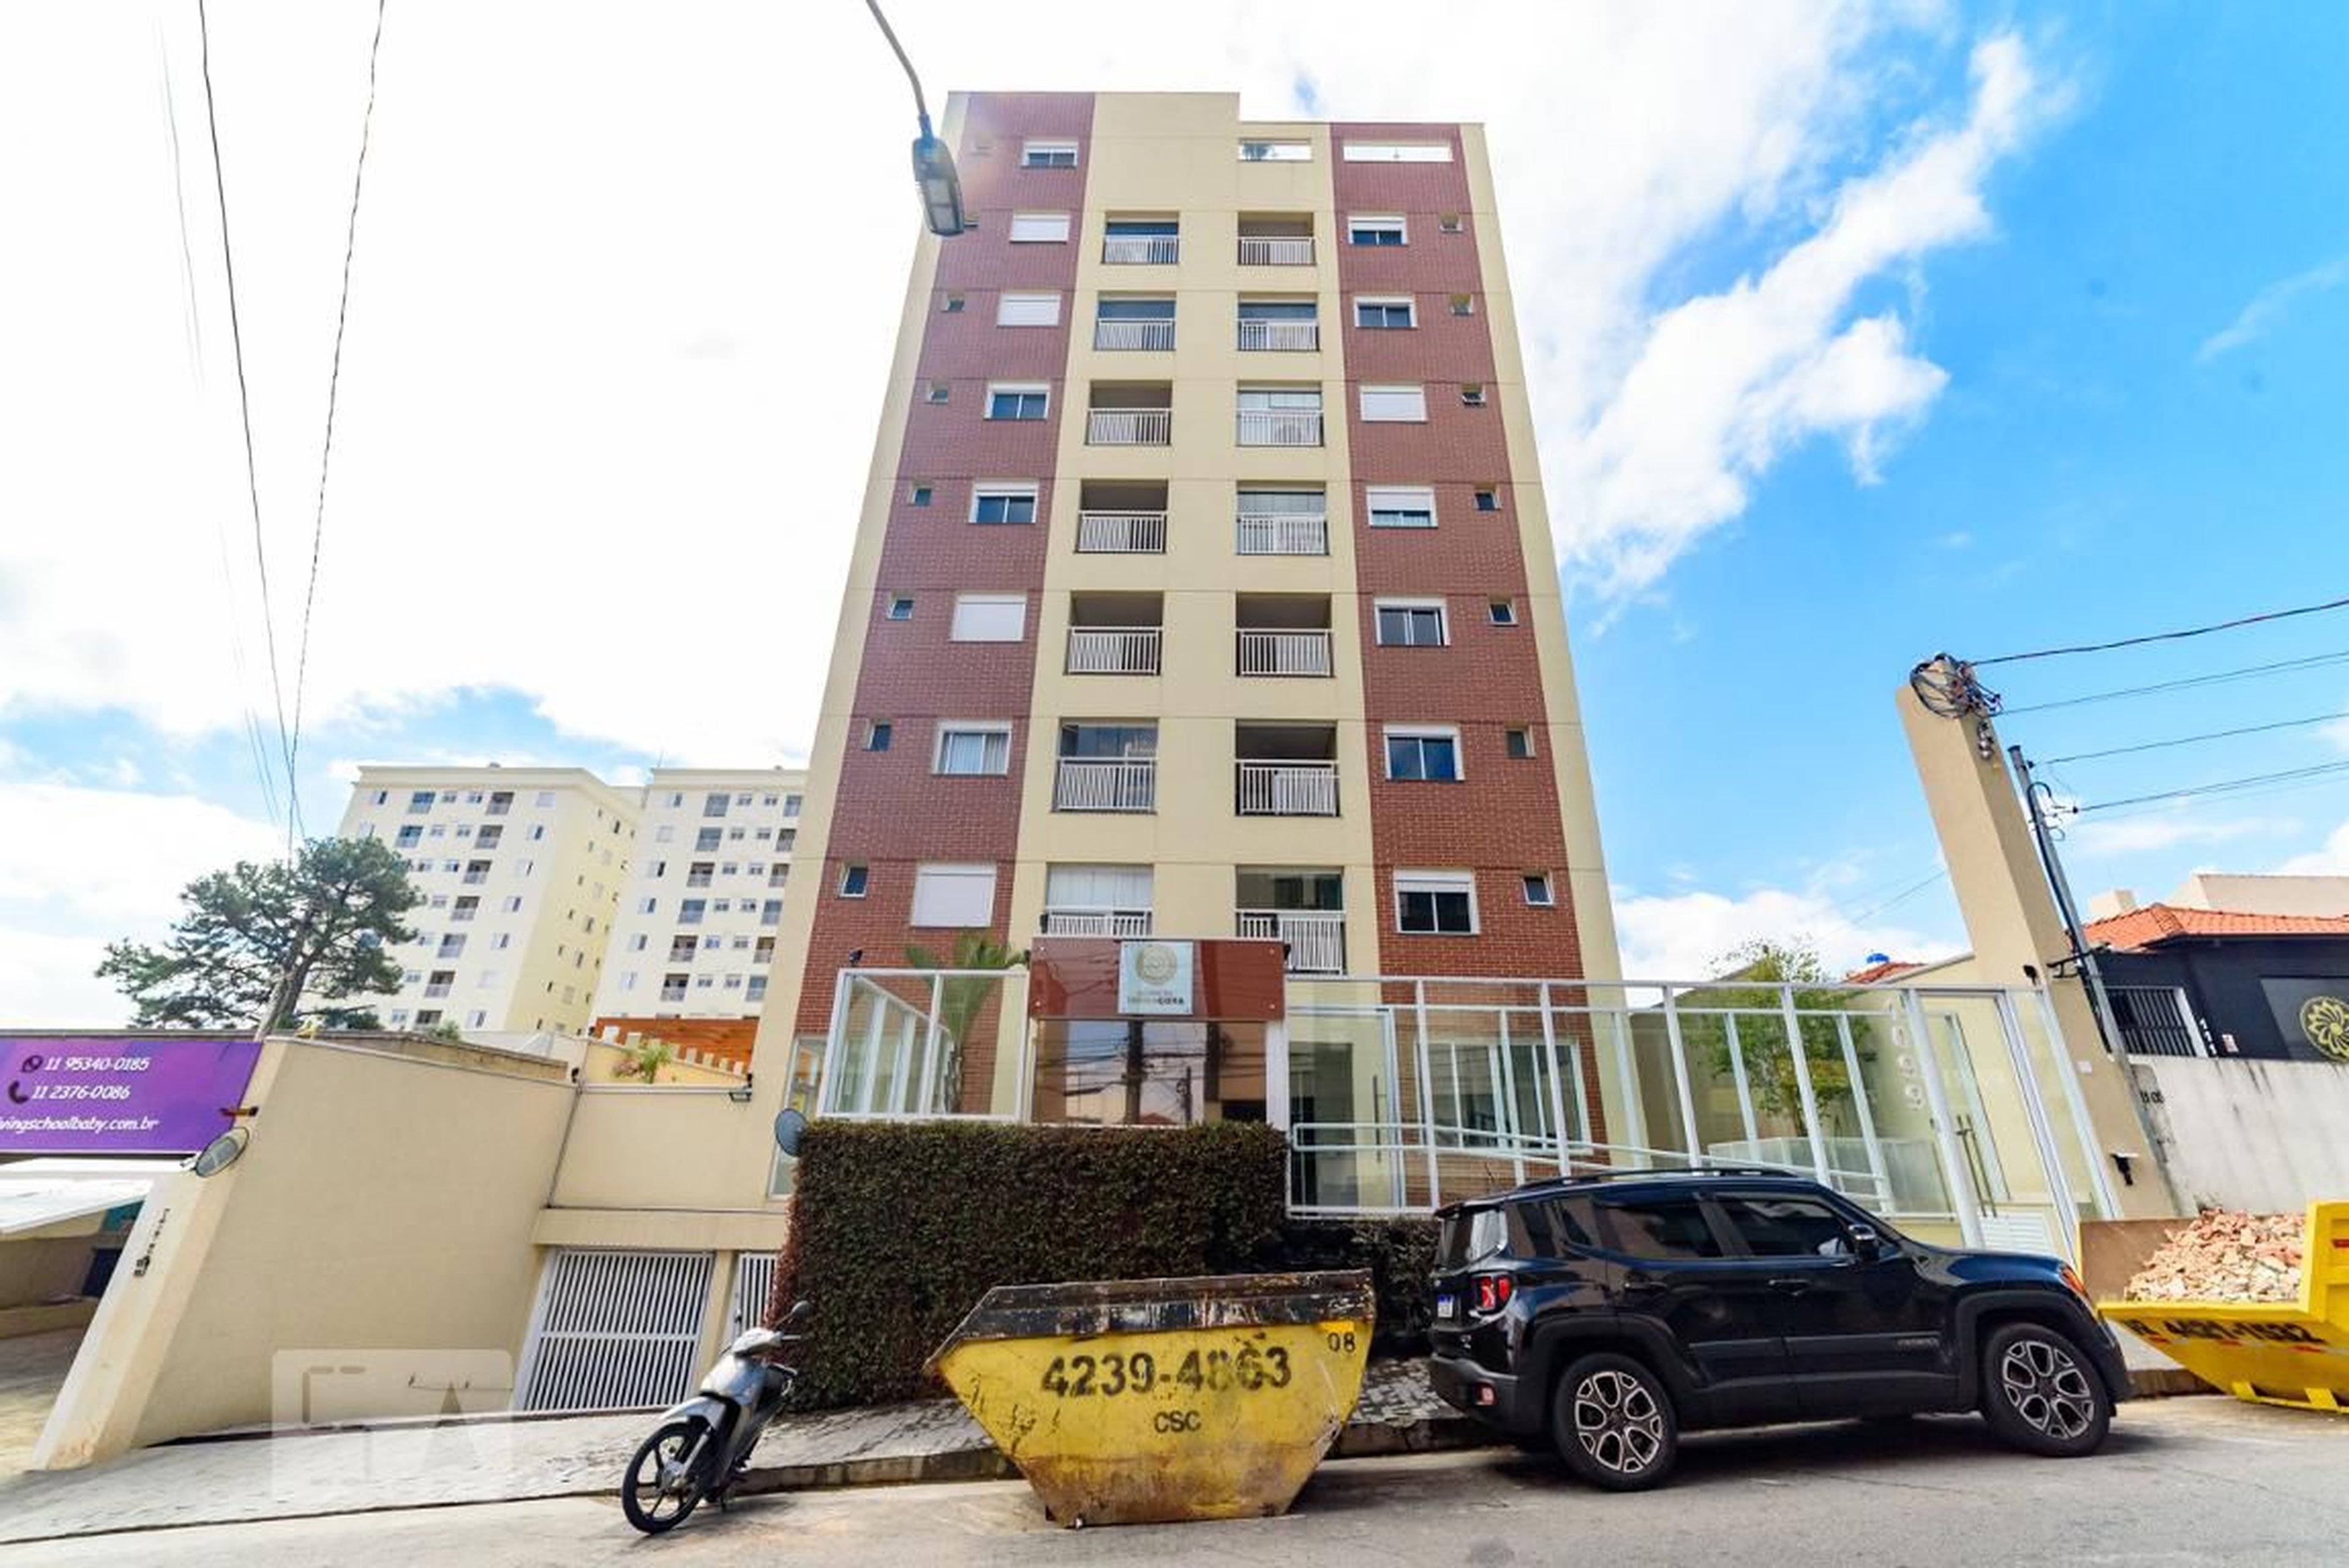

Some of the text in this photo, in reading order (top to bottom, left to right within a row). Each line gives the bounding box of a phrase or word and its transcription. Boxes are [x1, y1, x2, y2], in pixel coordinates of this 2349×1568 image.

[45, 1057, 150, 1071] 11 95340-0185
[31, 1085, 131, 1100] 11 2376-0086
[0, 1115, 159, 1134] vingschoolbaby.com.br
[1326, 1332, 1356, 1353] 08
[1153, 1410, 1202, 1434] CSC
